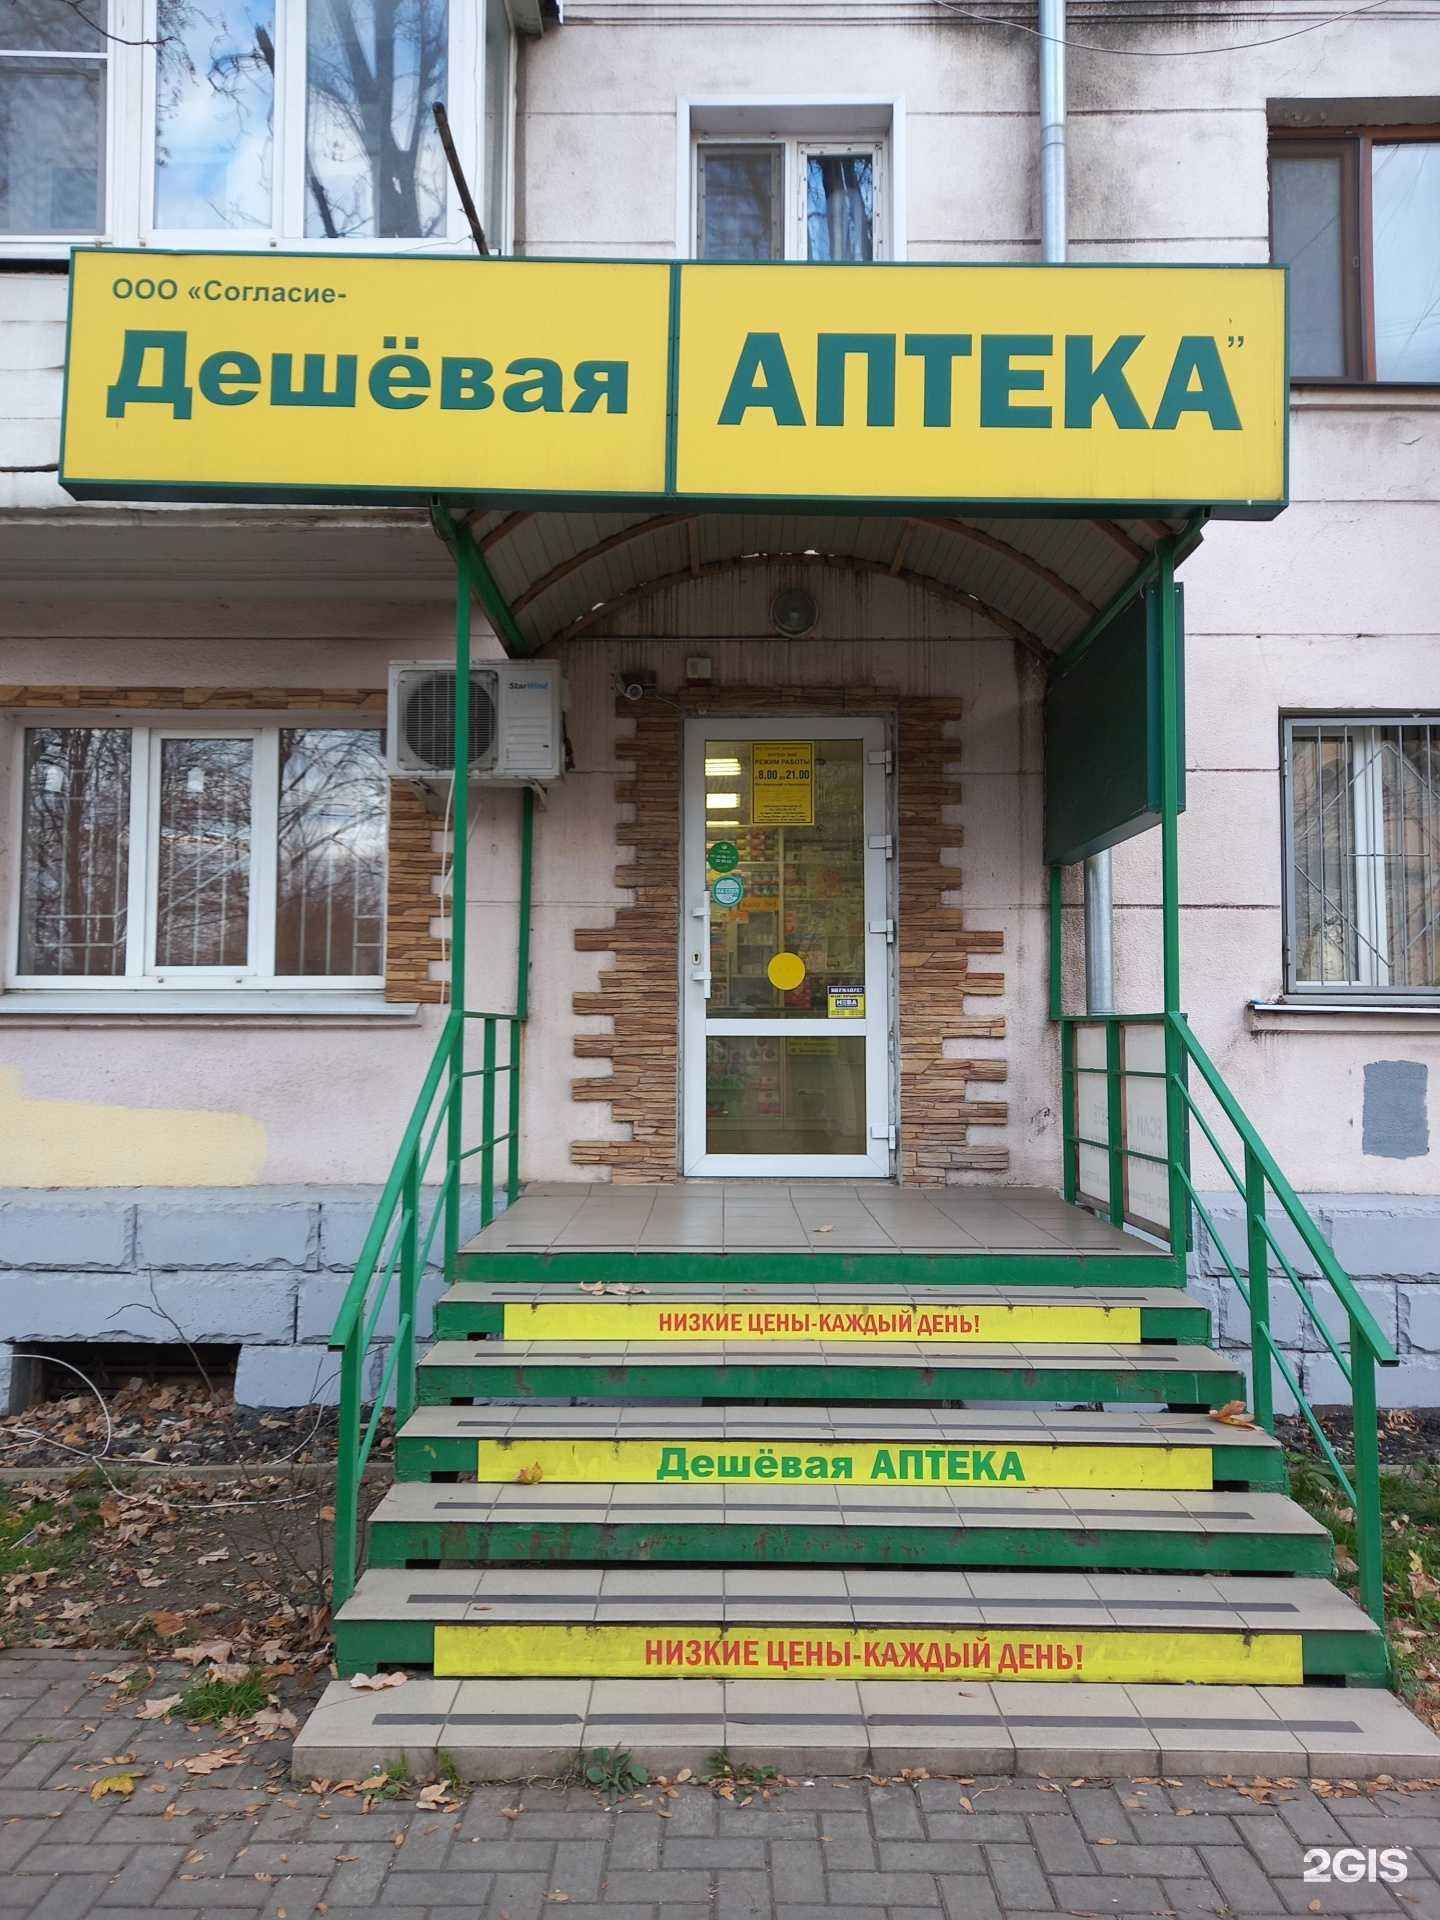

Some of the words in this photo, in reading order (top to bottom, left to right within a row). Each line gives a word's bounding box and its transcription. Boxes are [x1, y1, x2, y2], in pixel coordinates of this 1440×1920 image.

[112, 278, 178, 300] ООО
[187, 280, 347, 303] «Согласие-
[106, 329, 629, 420] Дешёвая
[659, 1313, 743, 1332] НИЗКИЕ
[748, 1310, 913, 1336] ЦЕНЫ-КАЖДЫЙ
[917, 1314, 980, 1336] ДЕНЬ!
[656, 1447, 853, 1480] Дешёвая
[870, 1449, 1026, 1481] АПТЕКА
[645, 1640, 760, 1666] НИЗКИЕ
[767, 1636, 991, 1673] ЦЕНЫ-КАЖДЫЙ
[997, 1644, 1083, 1674] ДЕНЬ!
